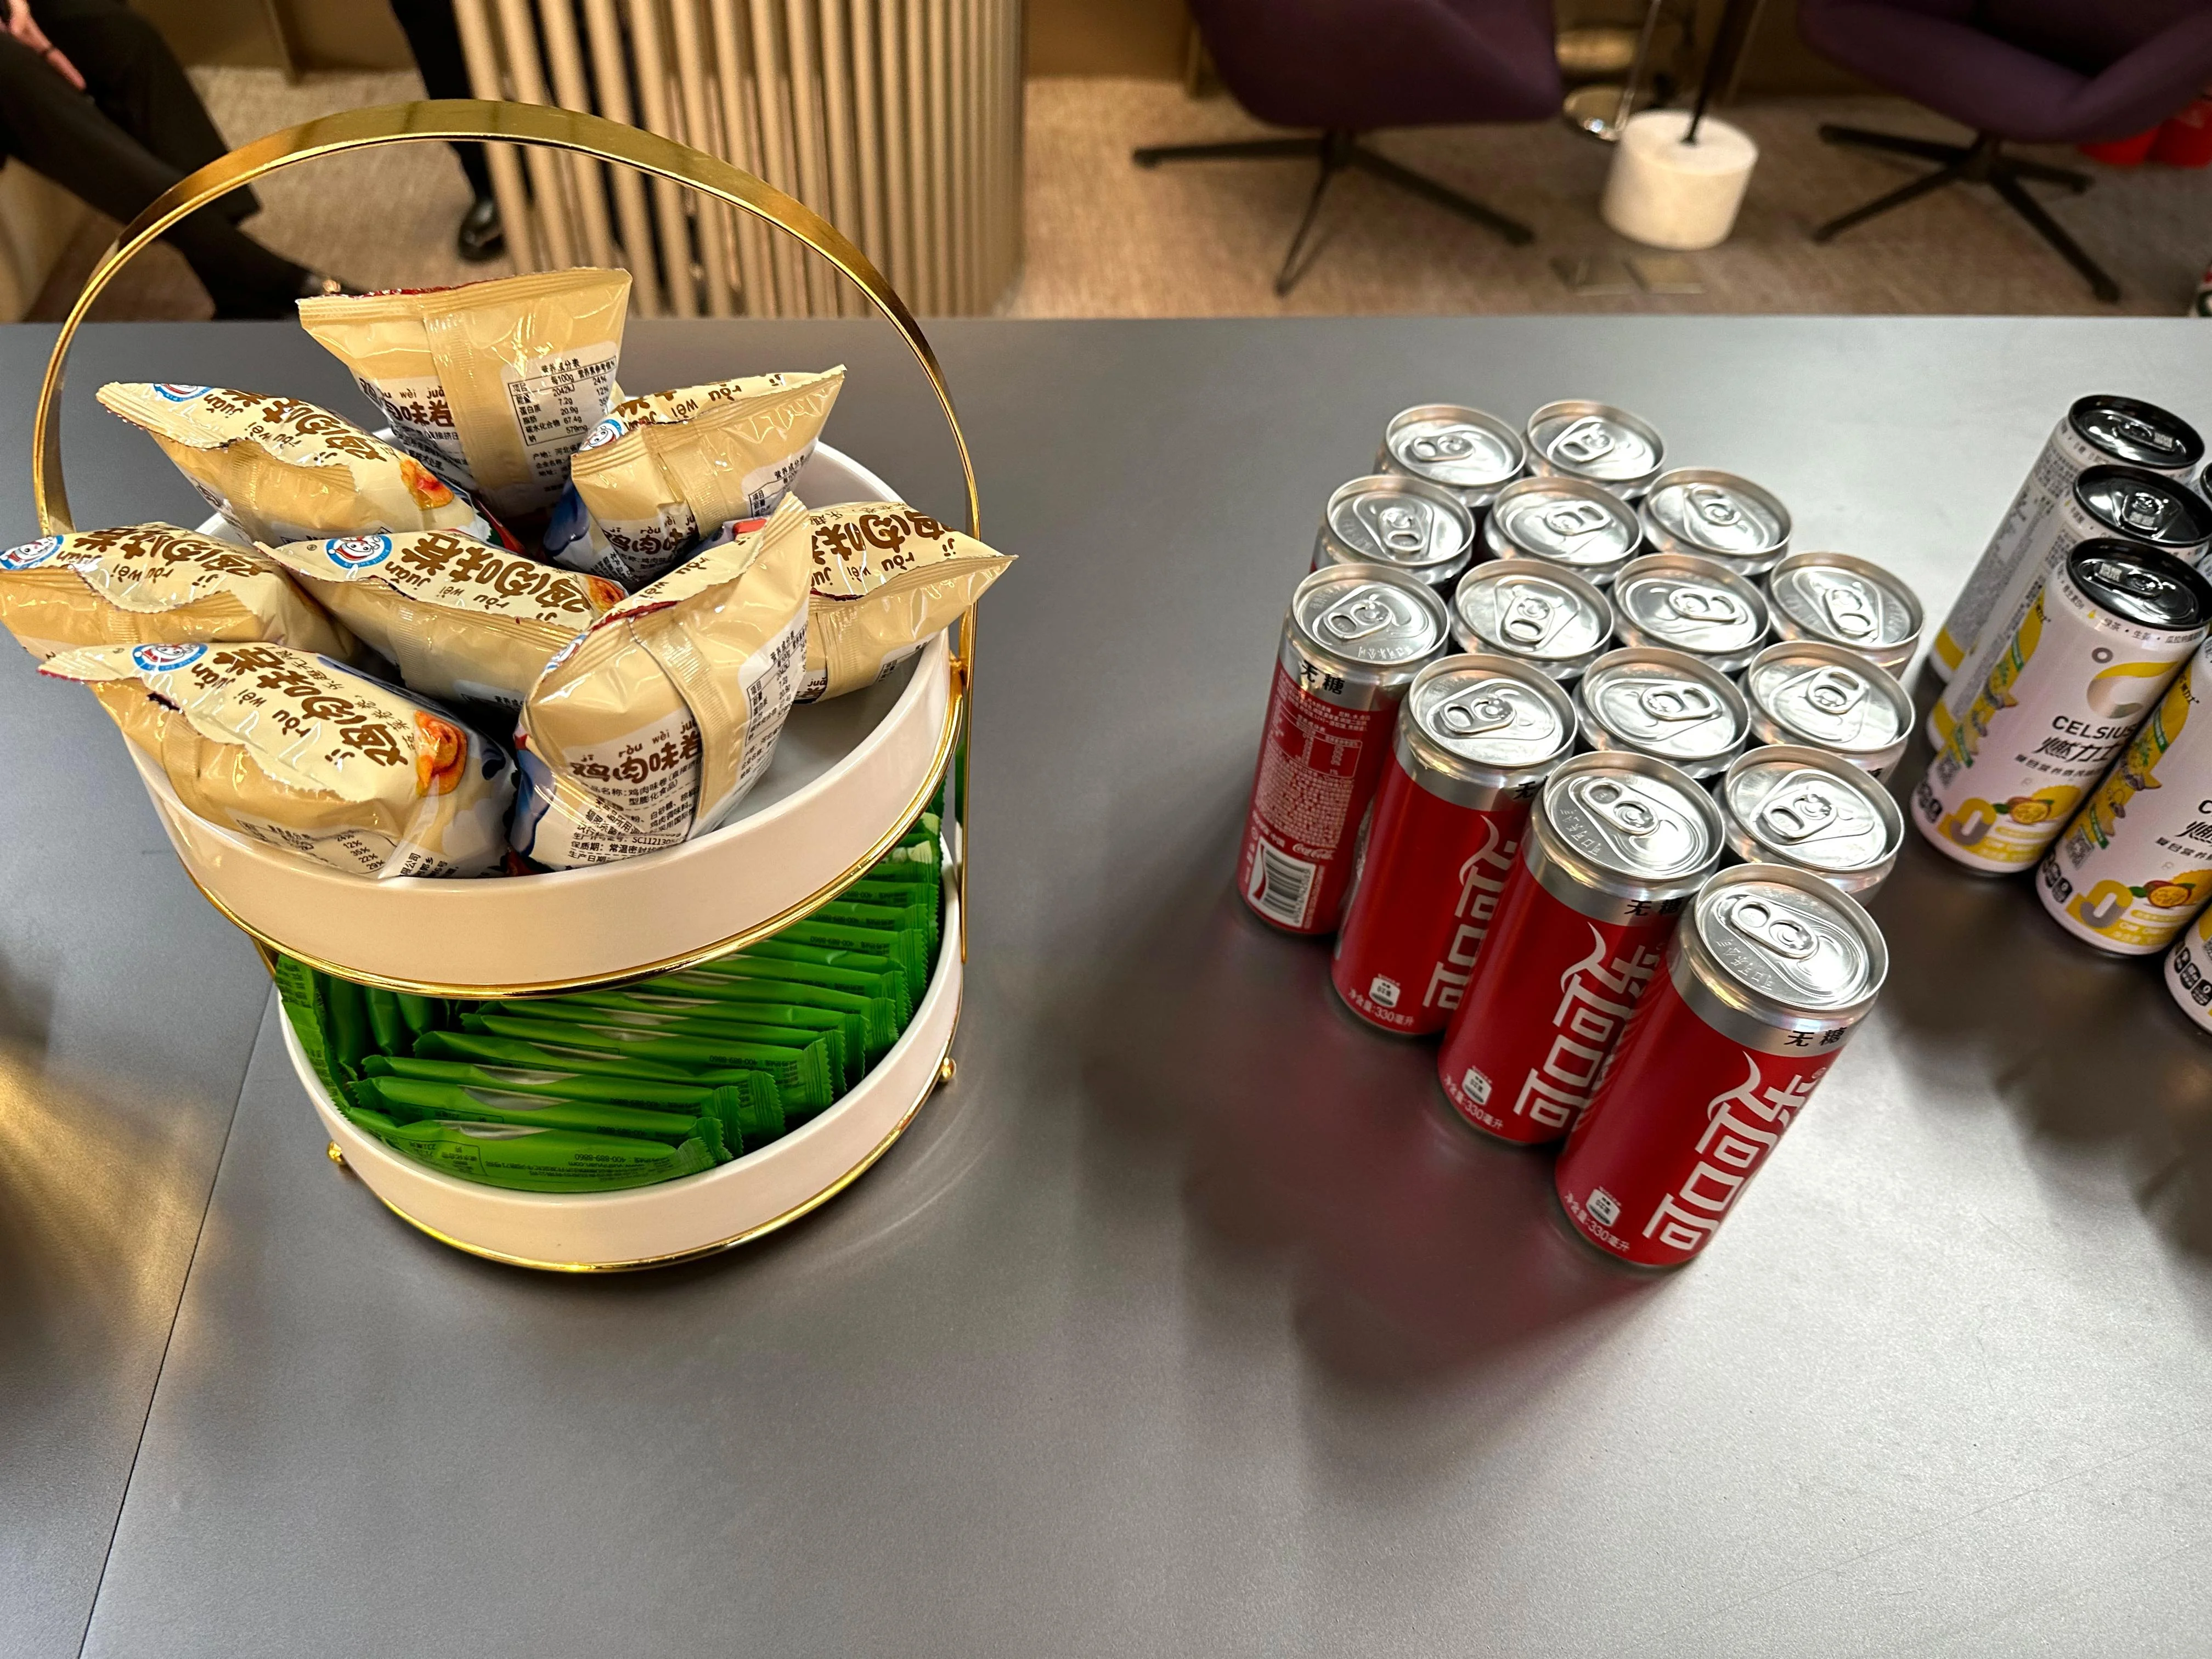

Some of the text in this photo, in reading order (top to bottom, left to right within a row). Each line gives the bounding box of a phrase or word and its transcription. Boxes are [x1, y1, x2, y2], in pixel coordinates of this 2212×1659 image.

[385, 561, 431, 591] juǎn
[401, 532, 594, 613] 鸡肉味卷
[439, 585, 463, 598] wèi
[473, 593, 510, 610] ròu
[1300, 659, 1345, 695] 无糖
[212, 647, 409, 766] 鸡肉味卷
[233, 688, 268, 708] wèi
[271, 709, 312, 738] ròu
[2052, 715, 2137, 740] CELSIUS
[618, 743, 642, 758] ròu
[652, 729, 670, 744] wèi
[343, 840, 363, 850] 12%
[1623, 895, 1685, 917] 无糖
[1782, 1026, 1848, 1048] 无糖
[1642, 1051, 1819, 1252] 可口可乐
